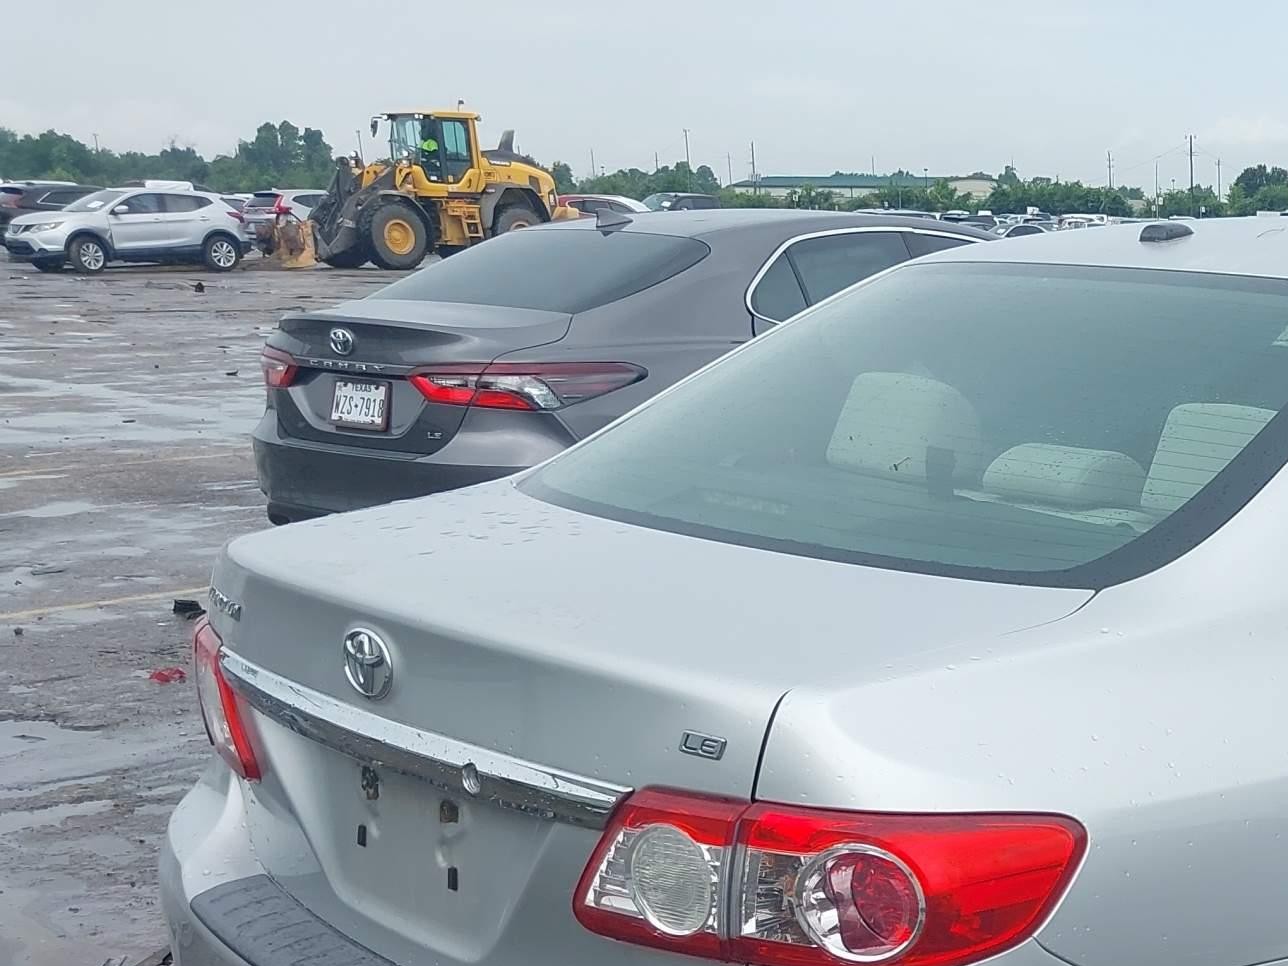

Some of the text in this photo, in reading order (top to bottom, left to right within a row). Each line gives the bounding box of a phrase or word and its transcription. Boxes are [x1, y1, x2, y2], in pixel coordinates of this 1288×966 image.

[310, 360, 385, 371] CAMRY
[352, 384, 372, 392] TEXAS
[682, 732, 722, 757] LE
